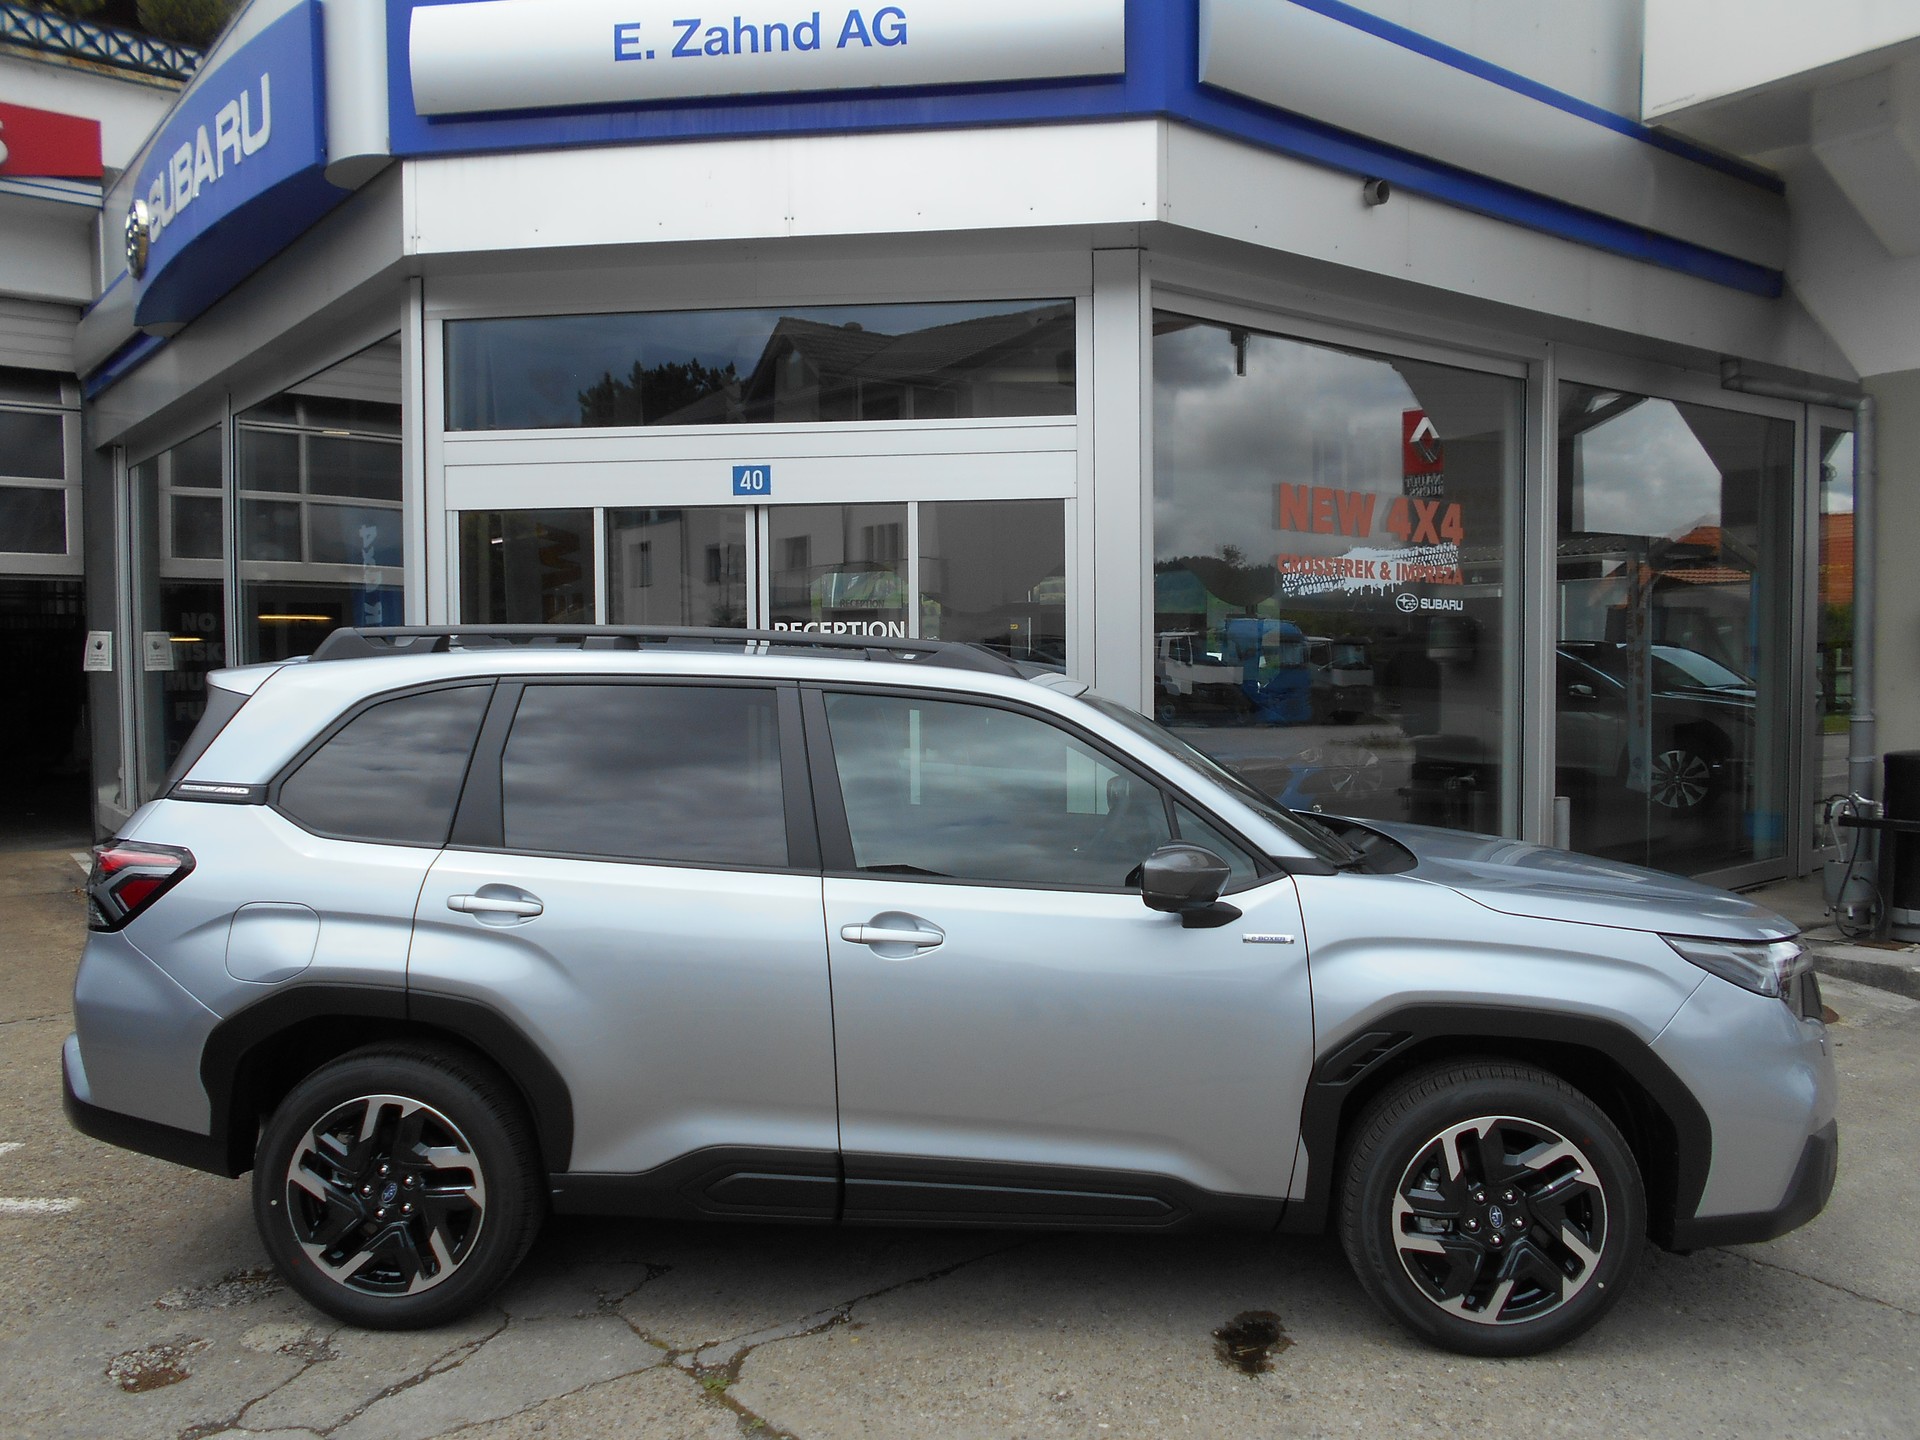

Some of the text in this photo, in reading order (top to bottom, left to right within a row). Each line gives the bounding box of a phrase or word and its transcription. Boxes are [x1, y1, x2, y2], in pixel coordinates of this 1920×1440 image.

[613, 6, 908, 62] E. Zahnd AG
[149, 72, 272, 243] SUBARU
[739, 469, 764, 490] 40
[1278, 481, 1466, 546] NEW 4X4
[1277, 552, 1465, 585] CROSSTREK & IMPREZA
[840, 599, 885, 608] RECEPTION
[1420, 597, 1465, 611] SUBARU
[181, 612, 218, 632] NO
[172, 642, 225, 662] ISK
